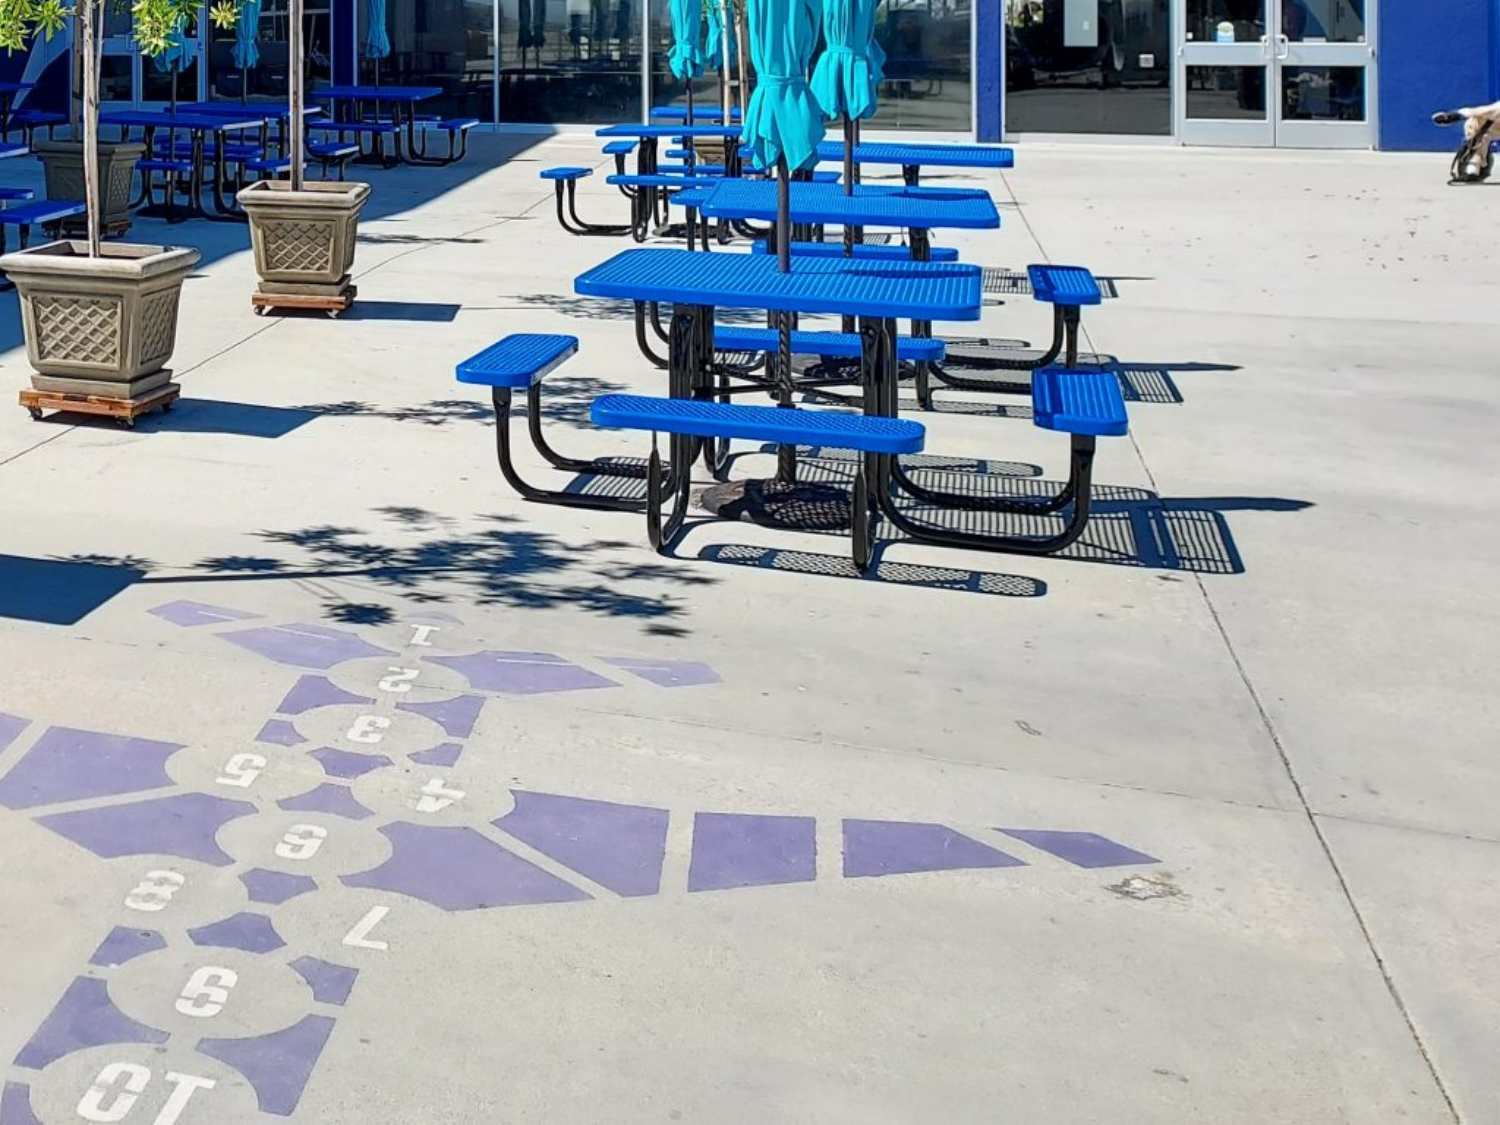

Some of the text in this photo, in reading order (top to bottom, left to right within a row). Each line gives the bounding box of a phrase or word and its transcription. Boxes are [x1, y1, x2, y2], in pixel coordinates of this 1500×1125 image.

[410, 624, 439, 646] 1
[378, 667, 420, 692] 2
[346, 715, 390, 743] 3
[215, 753, 267, 788] 5
[415, 778, 466, 812] 4
[275, 824, 328, 859] 6
[125, 871, 185, 911] 8
[342, 905, 390, 950] 7
[175, 966, 238, 1017] 9
[77, 1062, 216, 1125] 10
